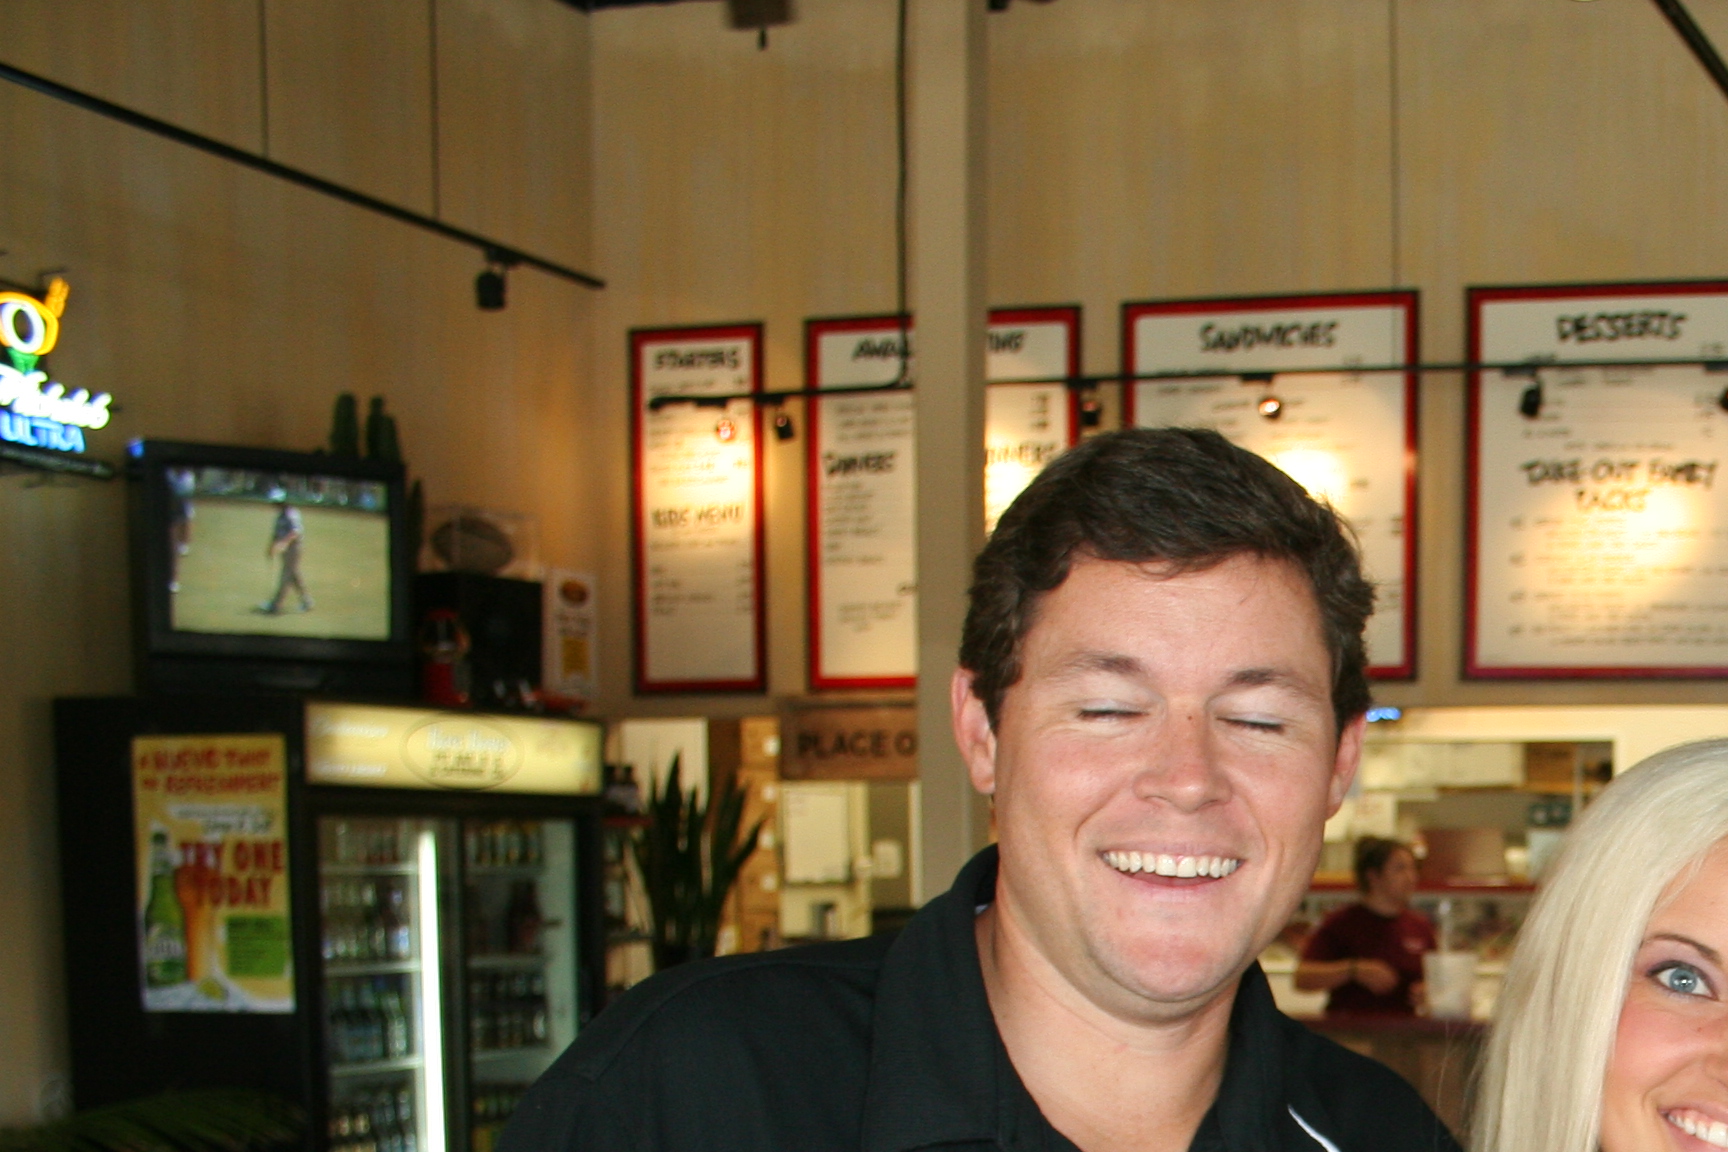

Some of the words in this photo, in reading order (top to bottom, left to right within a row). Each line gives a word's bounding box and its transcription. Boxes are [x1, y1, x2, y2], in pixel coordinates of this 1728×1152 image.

[1200, 320, 1339, 351] SANDWICHES
[1556, 310, 1689, 343] DESSERTS
[655, 347, 740, 369] STARTERS
[798, 730, 886, 758] PLACE
[233, 841, 283, 873] ONE
